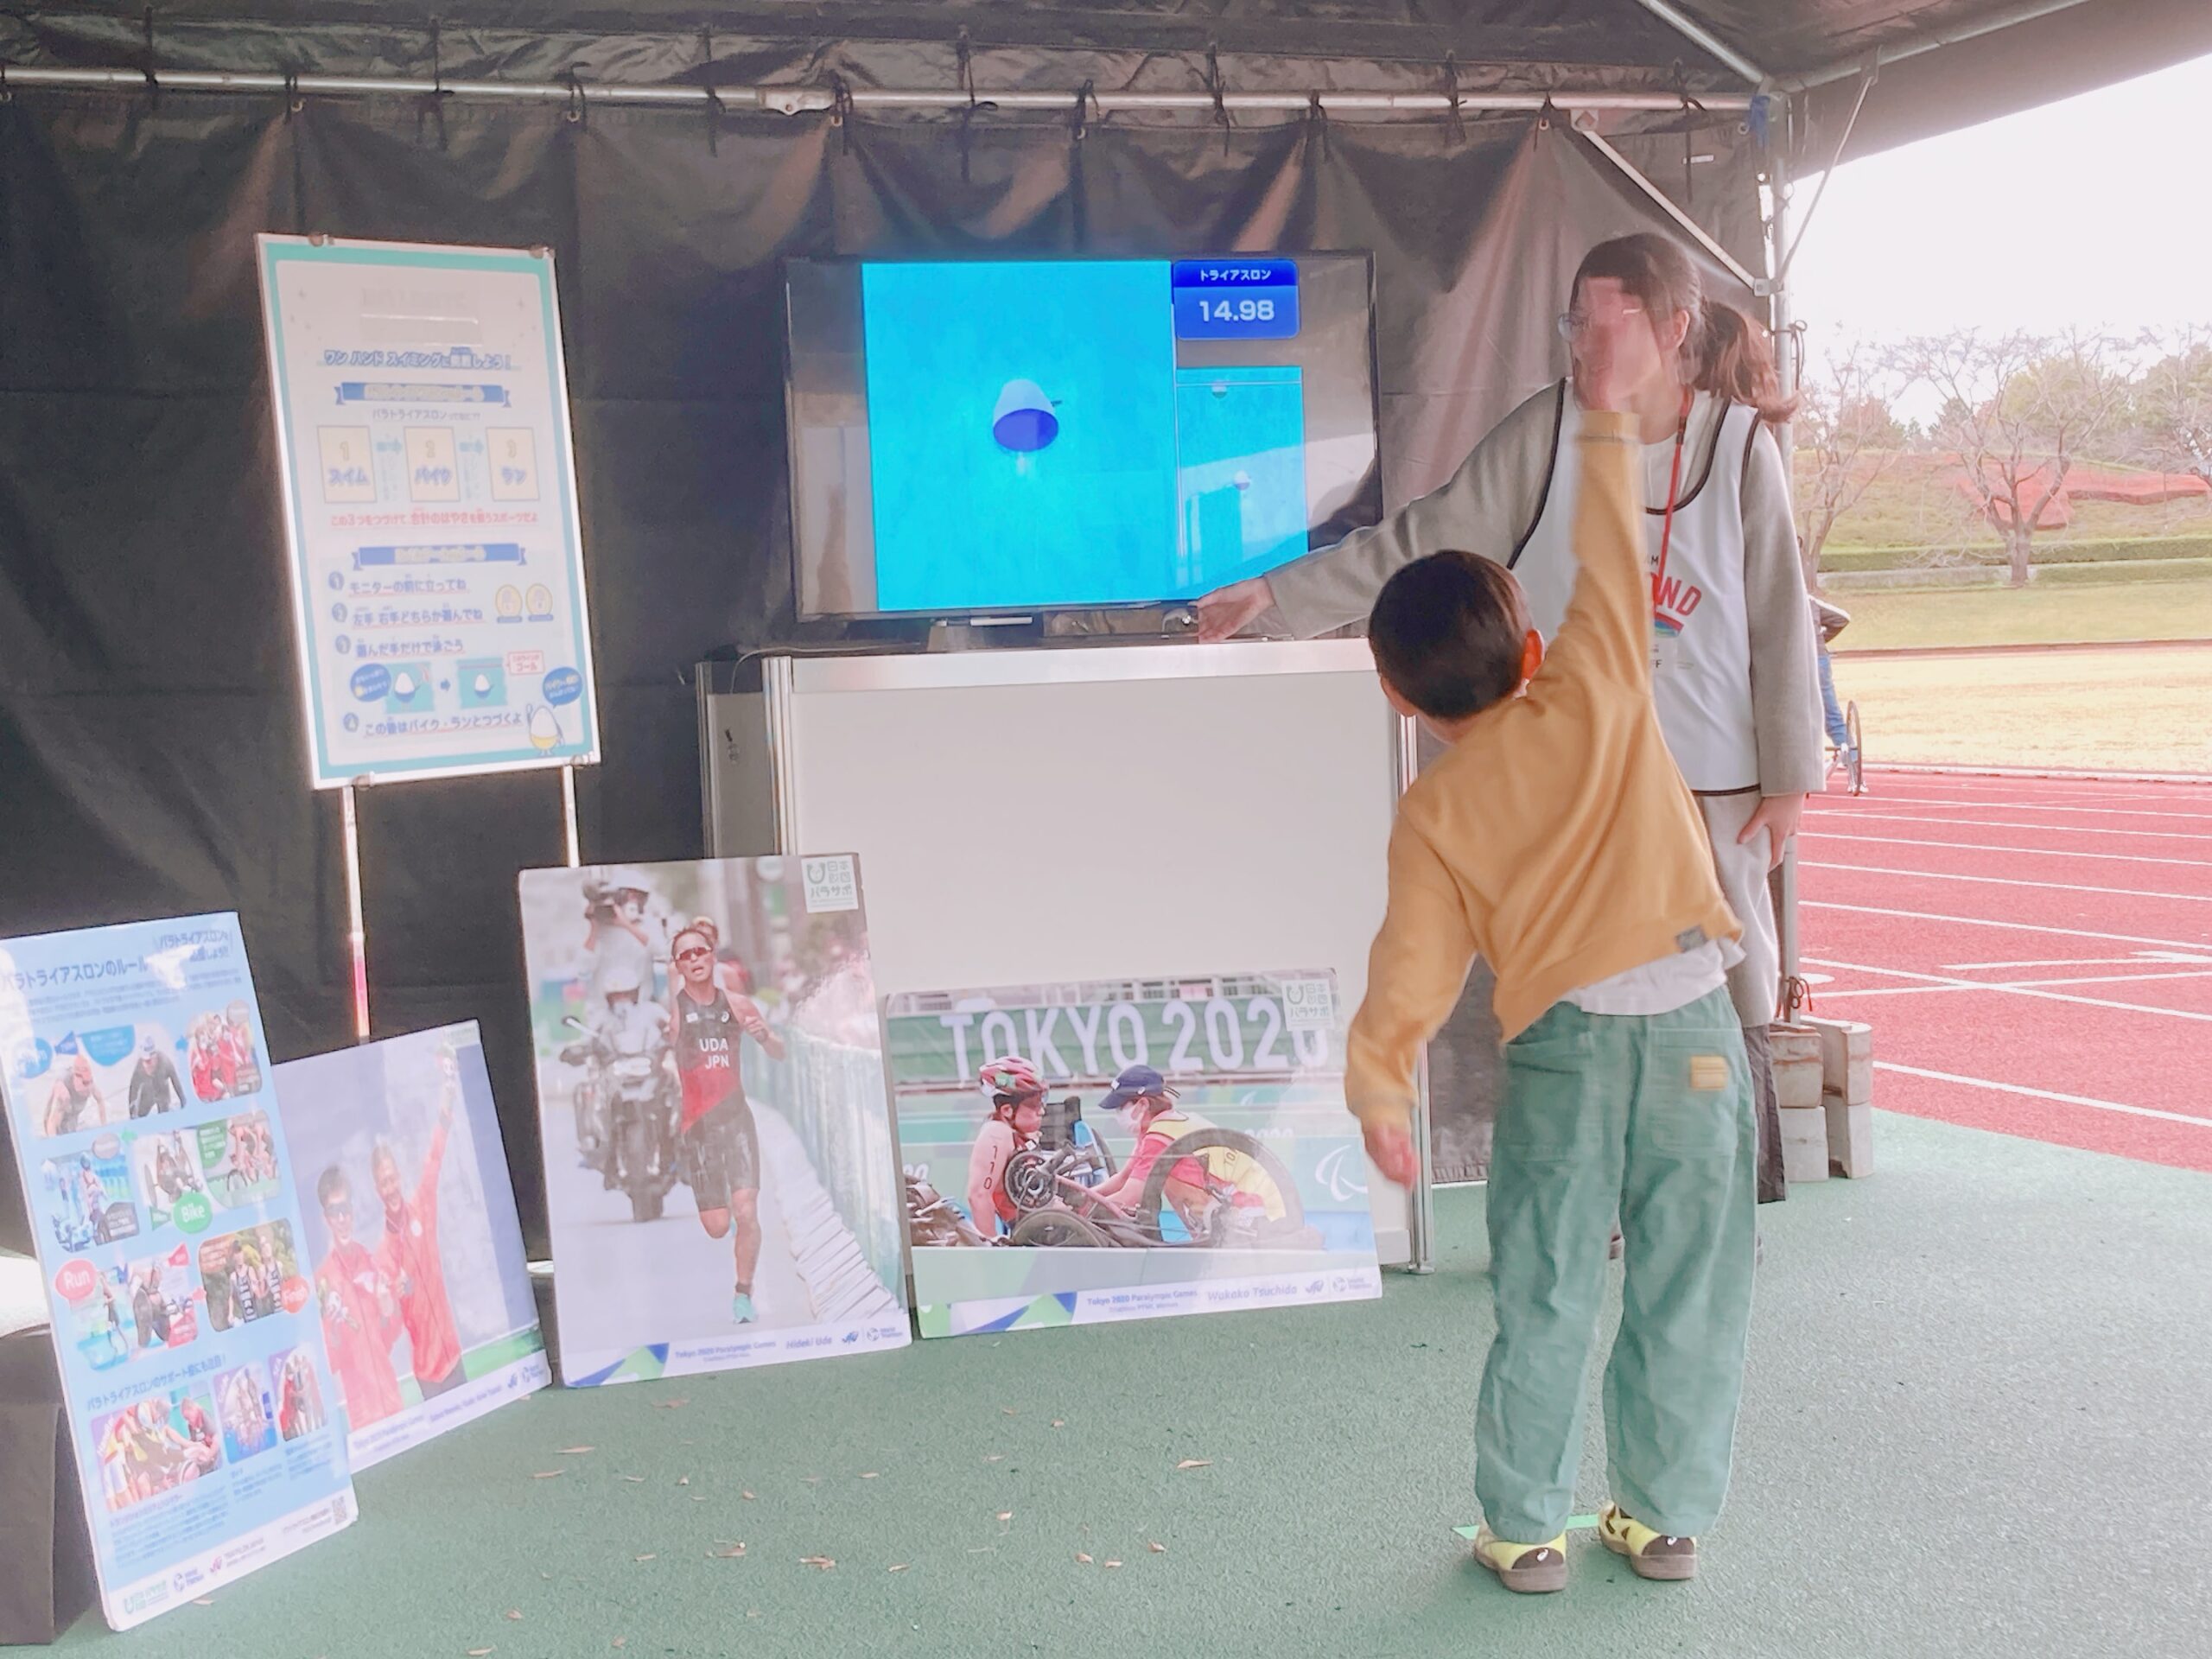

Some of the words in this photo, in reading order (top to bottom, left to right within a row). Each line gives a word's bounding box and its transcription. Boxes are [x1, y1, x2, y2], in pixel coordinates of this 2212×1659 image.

[1200, 269, 1272, 282] トライアスロン
[1198, 299, 1274, 322] 14.98
[324, 350, 347, 365] ワン
[350, 351, 385, 366] ハンド
[339, 441, 351, 461] 1
[328, 467, 371, 486] スイム
[500, 466, 527, 485] ラン
[699, 1038, 728, 1052] UDA
[940, 1002, 1149, 1081] TOKYO
[705, 1055, 730, 1070] JPN
[181, 1202, 207, 1223] Bike
[64, 1268, 91, 1289] Run
[1087, 1297, 1111, 1306] Tokyo
[1112, 1294, 1130, 1303] 2020
[1132, 1292, 1172, 1302] Paralympic
[1173, 1289, 1198, 1298] Games
[1207, 1288, 1250, 1301] Wakako
[1252, 1283, 1297, 1297] Tsuchida
